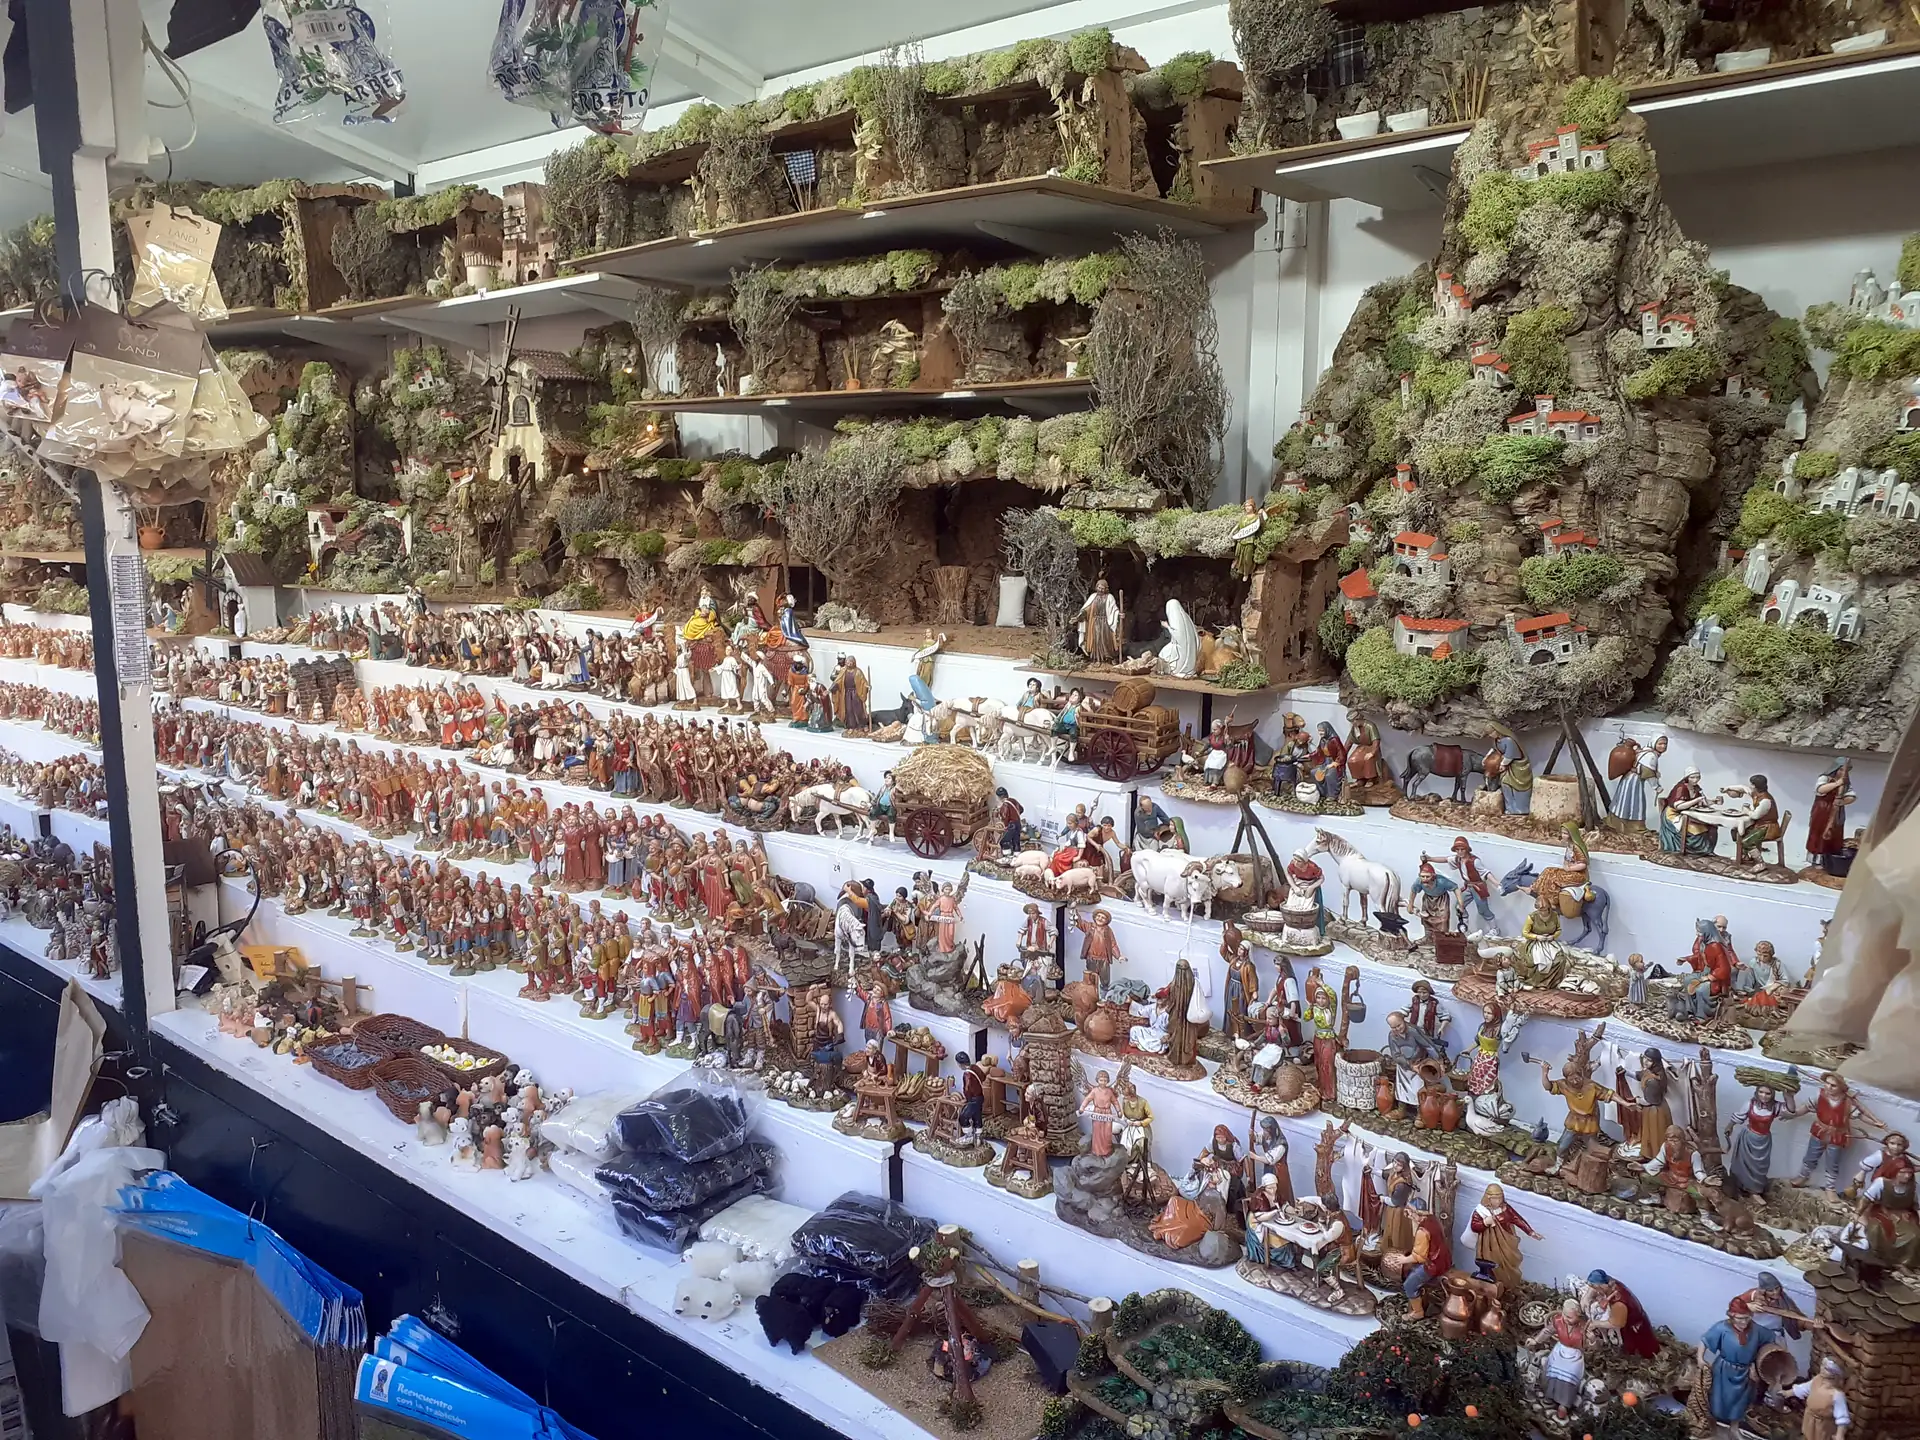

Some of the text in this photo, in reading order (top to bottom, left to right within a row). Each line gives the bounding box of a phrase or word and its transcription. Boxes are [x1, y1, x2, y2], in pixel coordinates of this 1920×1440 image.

[168, 228, 198, 245] LANDI
[117, 342, 160, 360] LANDI
[395, 1396, 413, 1406] con
[396, 1382, 453, 1411] Reencuentro
